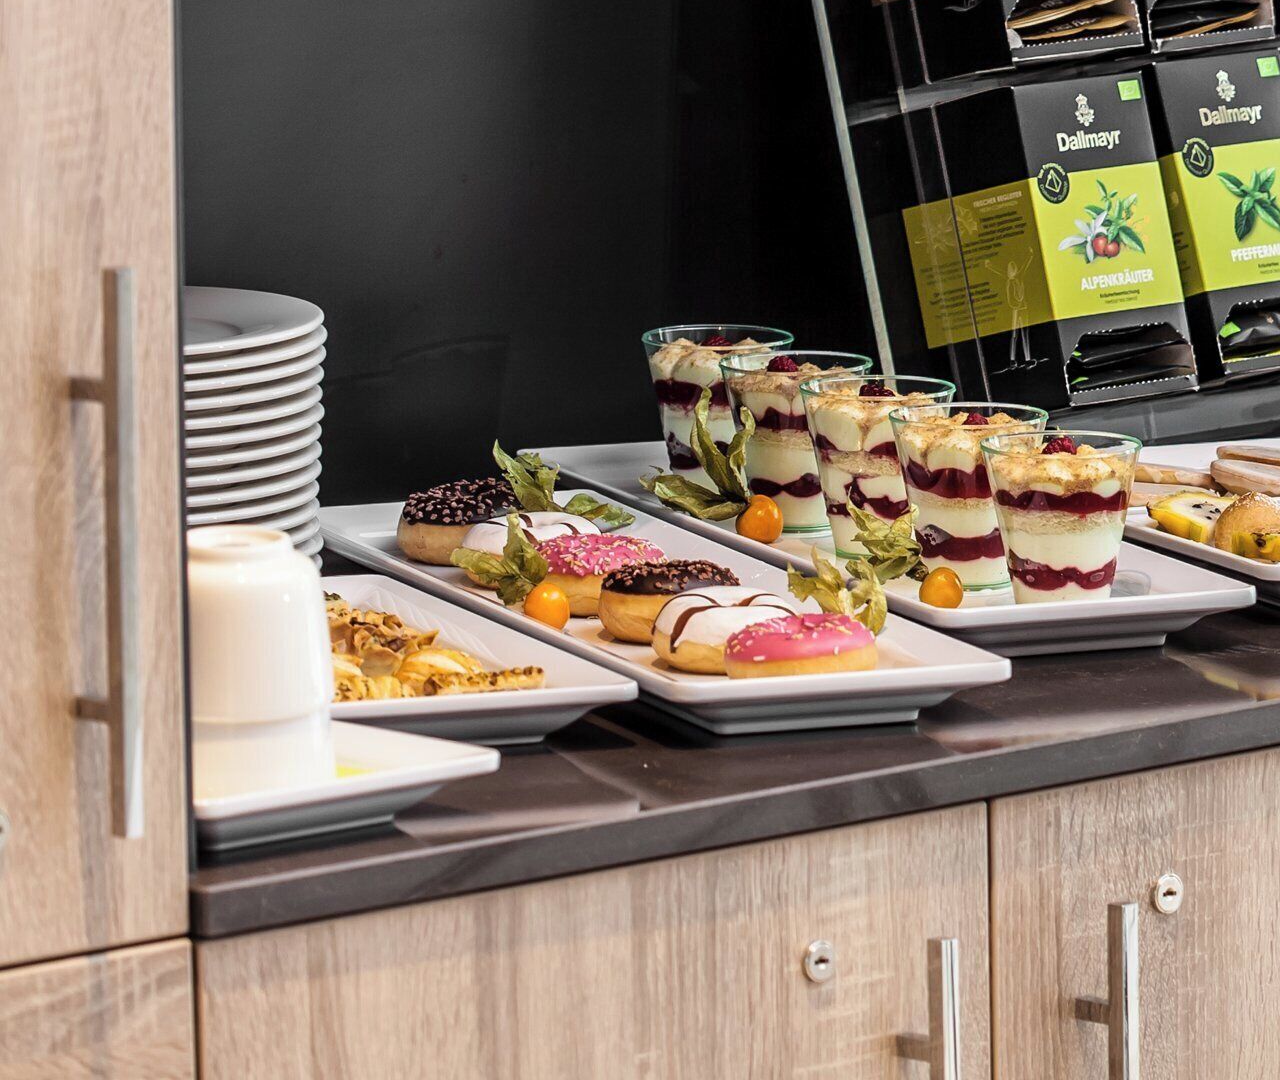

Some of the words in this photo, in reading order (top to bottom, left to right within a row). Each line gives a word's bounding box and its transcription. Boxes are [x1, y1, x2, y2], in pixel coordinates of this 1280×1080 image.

[1198, 104, 1262, 127] Dallmayr
[1056, 129, 1121, 153] Dallmayr
[1080, 267, 1155, 291] ALPENKRÄUTER
